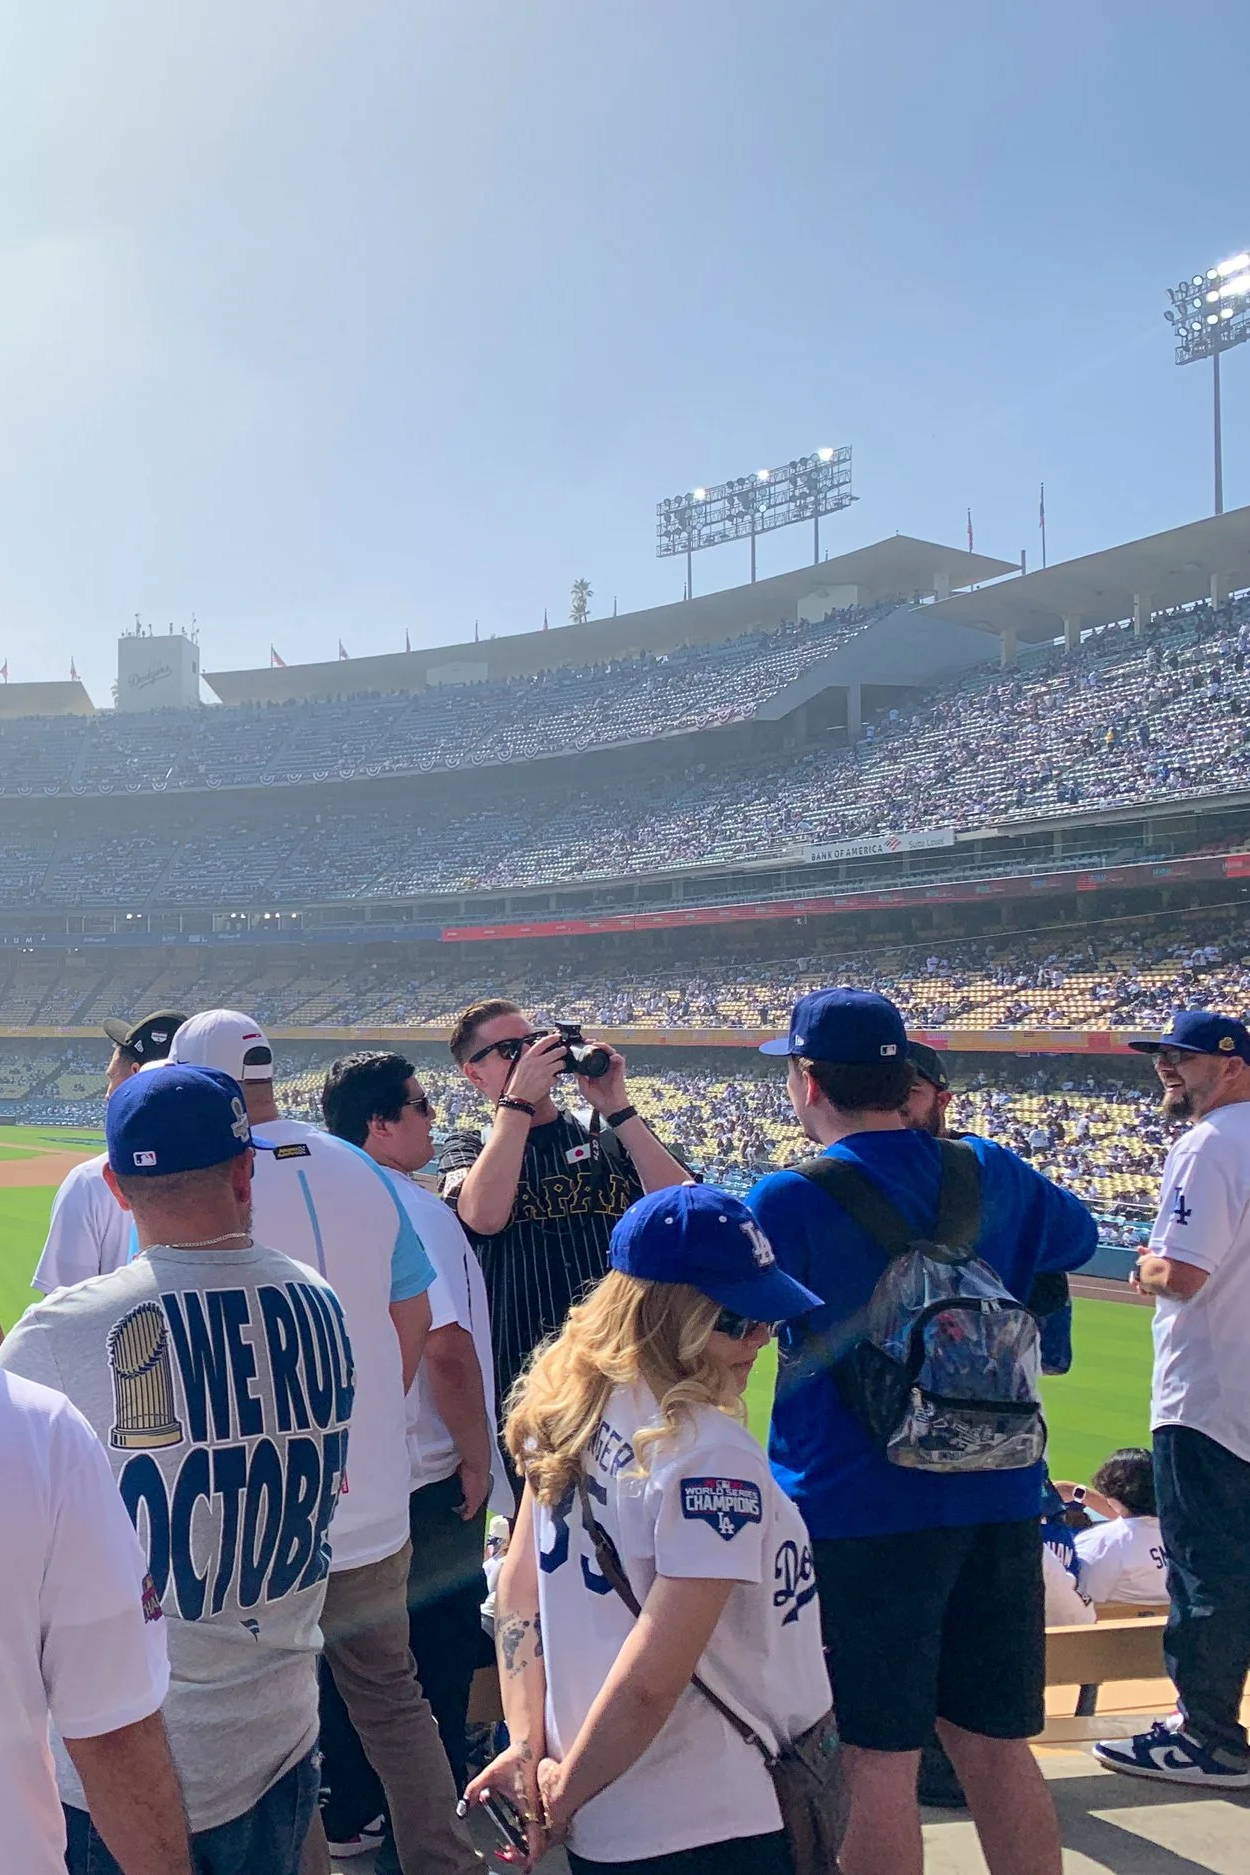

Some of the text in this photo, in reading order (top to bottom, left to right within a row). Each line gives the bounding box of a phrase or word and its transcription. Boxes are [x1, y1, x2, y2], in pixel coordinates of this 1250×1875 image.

[811, 850, 833, 862] BANK
[834, 849, 845, 858] OF
[846, 844, 883, 856] AMERICA
[739, 1220, 775, 1267] LA
[159, 1287, 265, 1445] WE
[685, 1487, 759, 1500] WORLD SERIES
[685, 1494, 760, 1516] CHAMPIONS
[717, 1511, 735, 1534] LA
